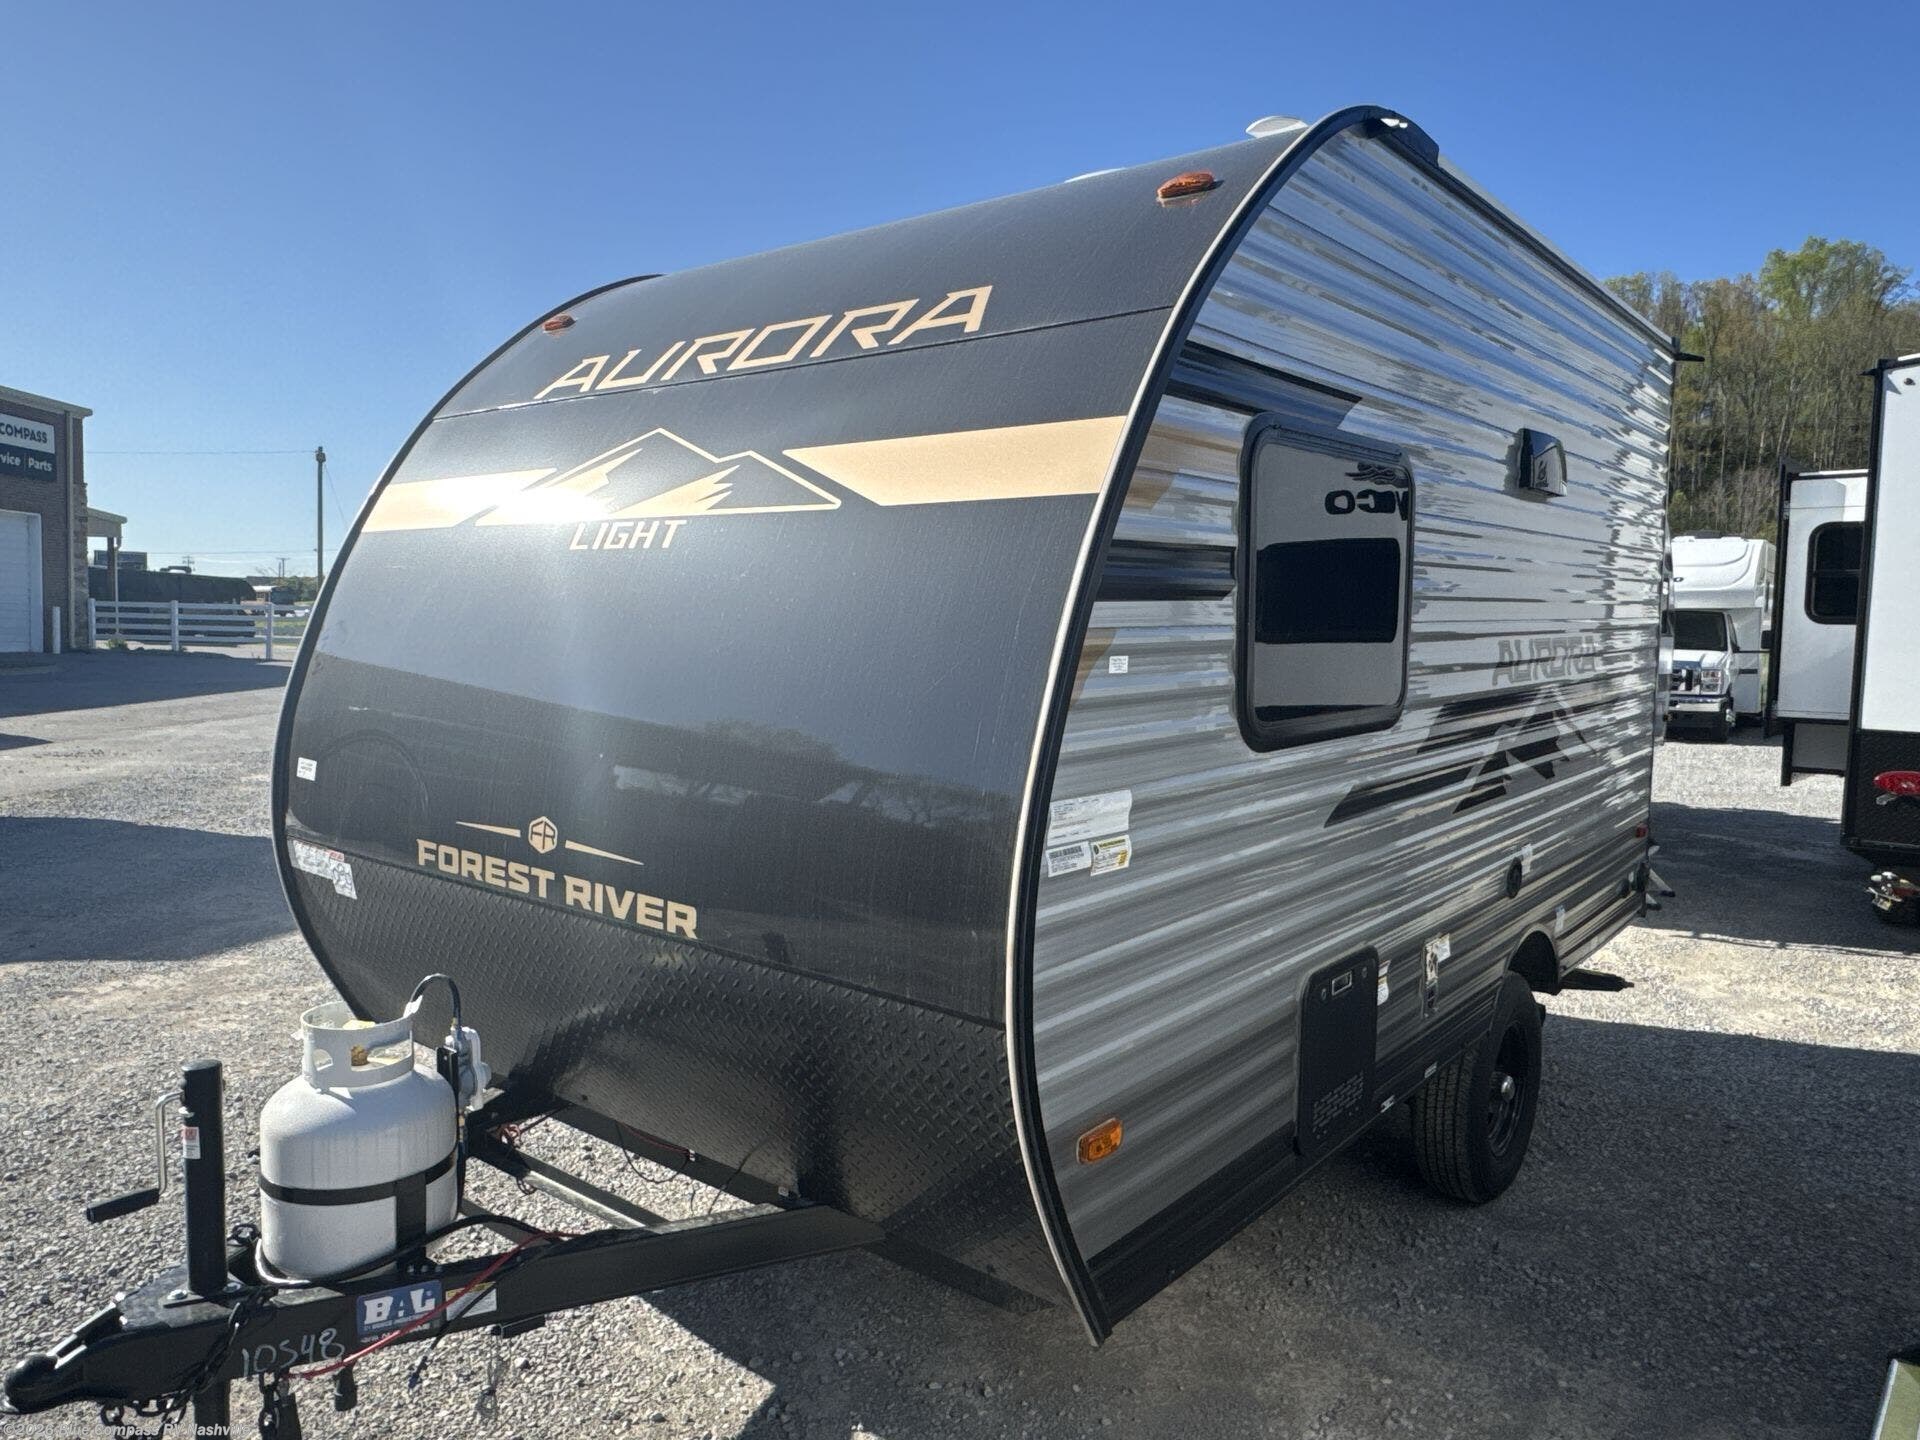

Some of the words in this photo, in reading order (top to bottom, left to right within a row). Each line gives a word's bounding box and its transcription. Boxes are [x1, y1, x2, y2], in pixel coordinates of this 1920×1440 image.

[533, 285, 993, 400] AURORA
[0, 423, 48, 444] COMPASS
[28, 457, 53, 472] Parts
[569, 520, 687, 550] LIGHT
[416, 838, 555, 898] FOREST
[563, 874, 698, 940] RIVER
[242, 1328, 345, 1377] 10548
